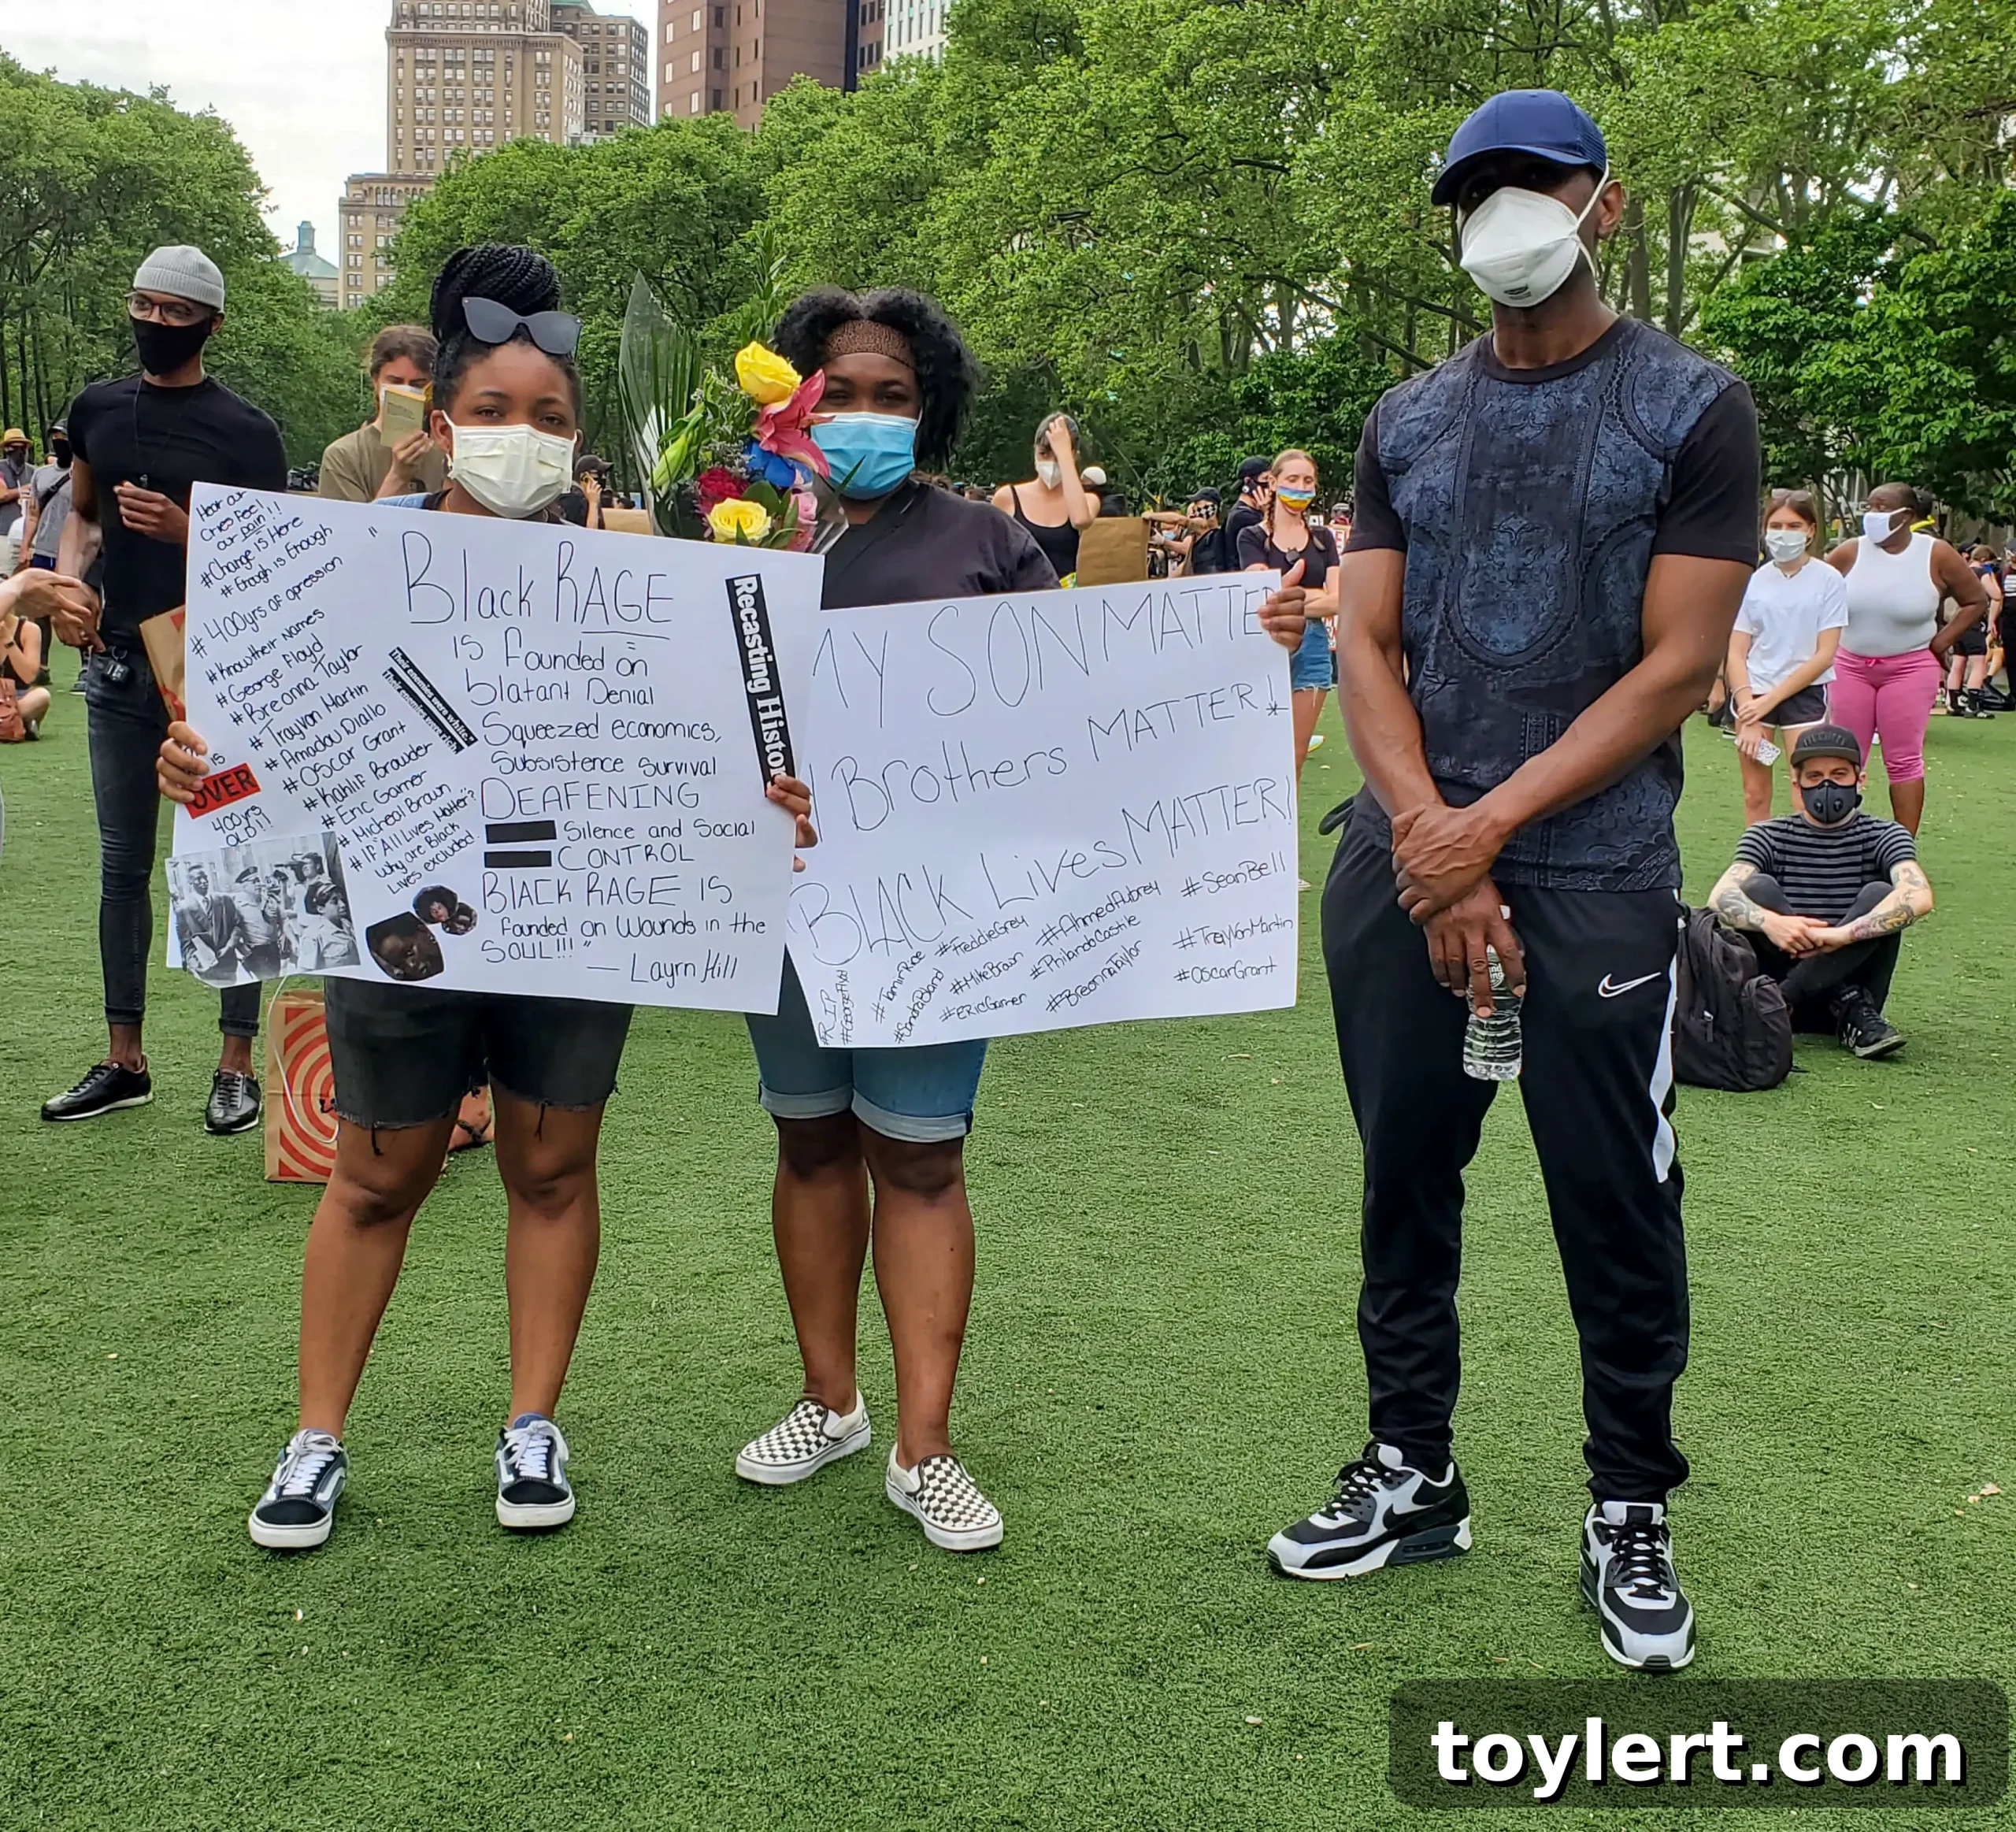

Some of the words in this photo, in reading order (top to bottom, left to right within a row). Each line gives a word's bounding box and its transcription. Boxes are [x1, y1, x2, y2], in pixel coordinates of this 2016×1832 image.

[285, 524, 333, 560] Enough
[555, 540, 674, 625] RAGE
[282, 632, 324, 669] Floyd
[313, 644, 363, 678] Taylor
[615, 655, 648, 677] on
[926, 600, 1090, 718] SON
[320, 684, 369, 714] Martin
[586, 677, 655, 706] Denial
[733, 575, 774, 695] Recasting
[756, 694, 788, 788] Histor
[340, 703, 387, 736] Diallo
[362, 720, 407, 751] Grant
[481, 710, 600, 750] Squeezed
[491, 749, 625, 777] Subsistence
[480, 777, 700, 821] DEAFENING
[830, 740, 1068, 833] Brothers
[405, 844, 426, 863] are
[424, 821, 461, 848] Black
[562, 820, 636, 843] Silence
[648, 818, 683, 839] and
[557, 843, 695, 872] CONTROL
[387, 870, 422, 895] Lives
[586, 870, 682, 907] RAGE
[580, 919, 607, 938] on
[704, 915, 721, 933] in
[728, 911, 767, 935] the
[700, 948, 738, 984] Hill
